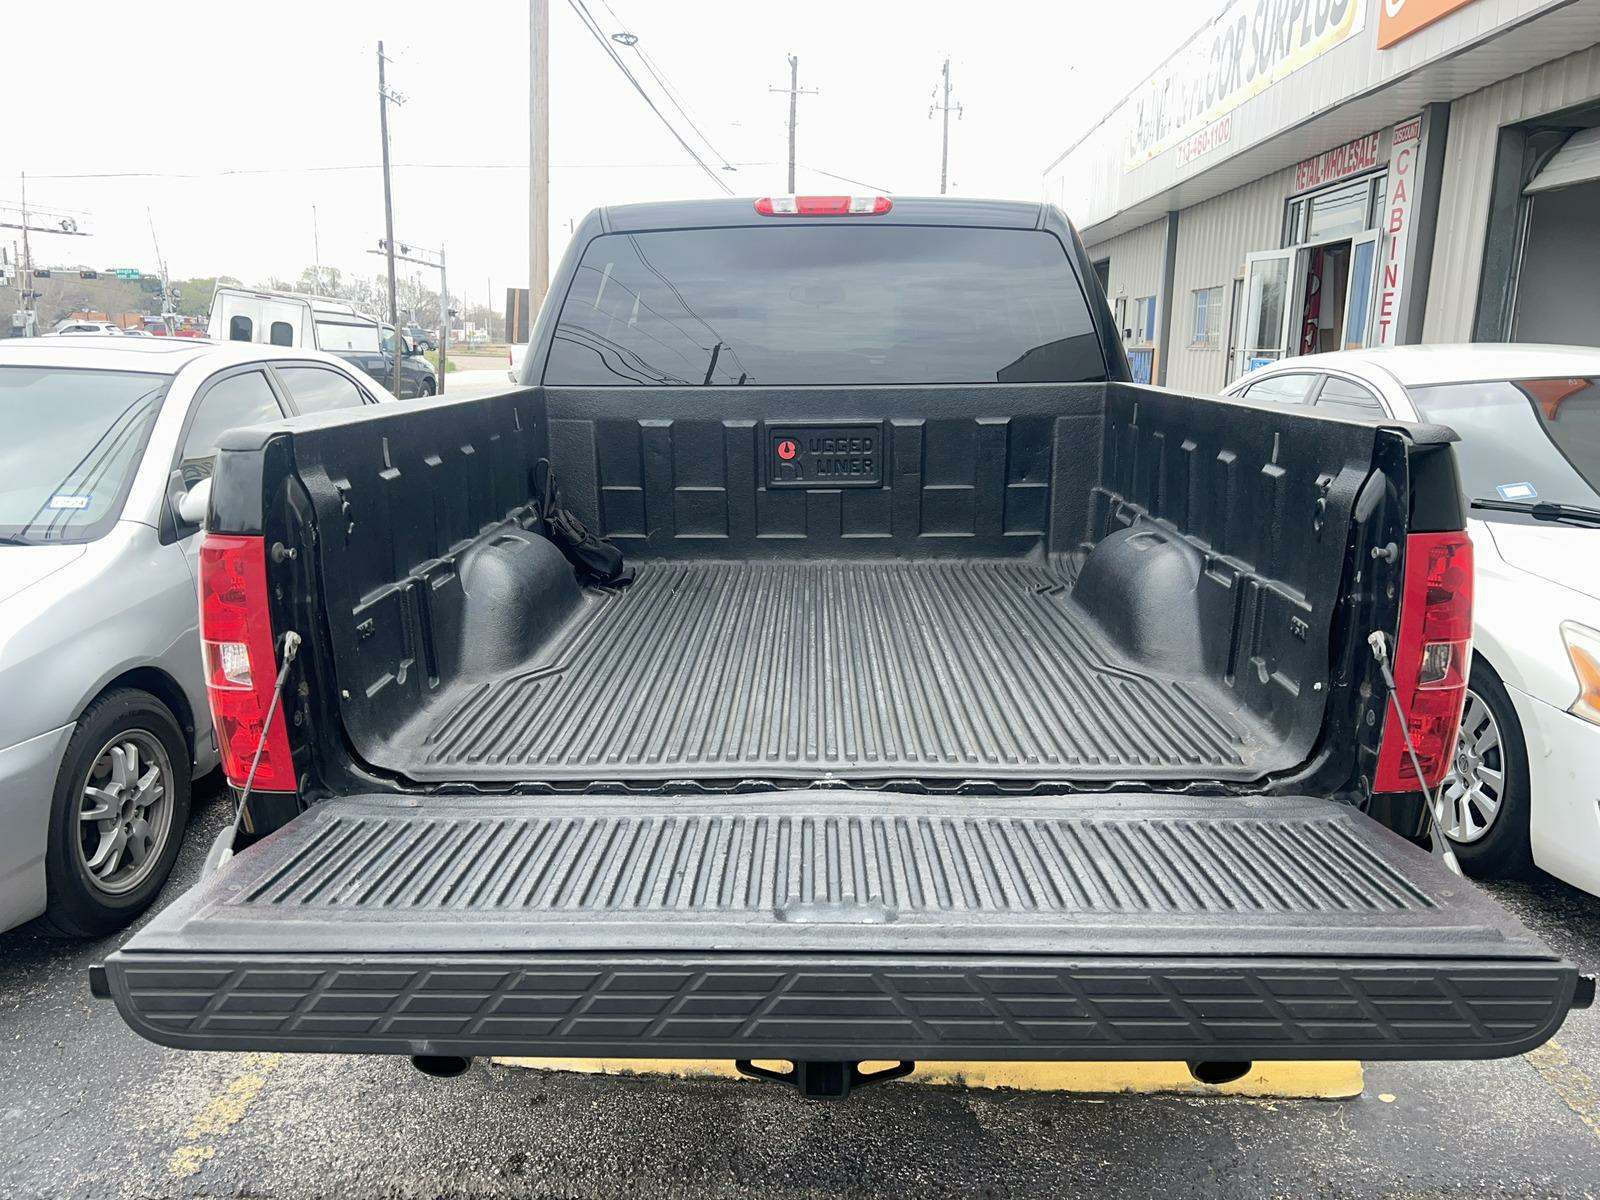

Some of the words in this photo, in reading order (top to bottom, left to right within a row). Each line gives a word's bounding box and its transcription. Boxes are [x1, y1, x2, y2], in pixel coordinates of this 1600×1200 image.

[1246, 0, 1350, 83] SURPL
[1379, 149, 1411, 344] CABINET
[816, 459, 874, 476] LINER
